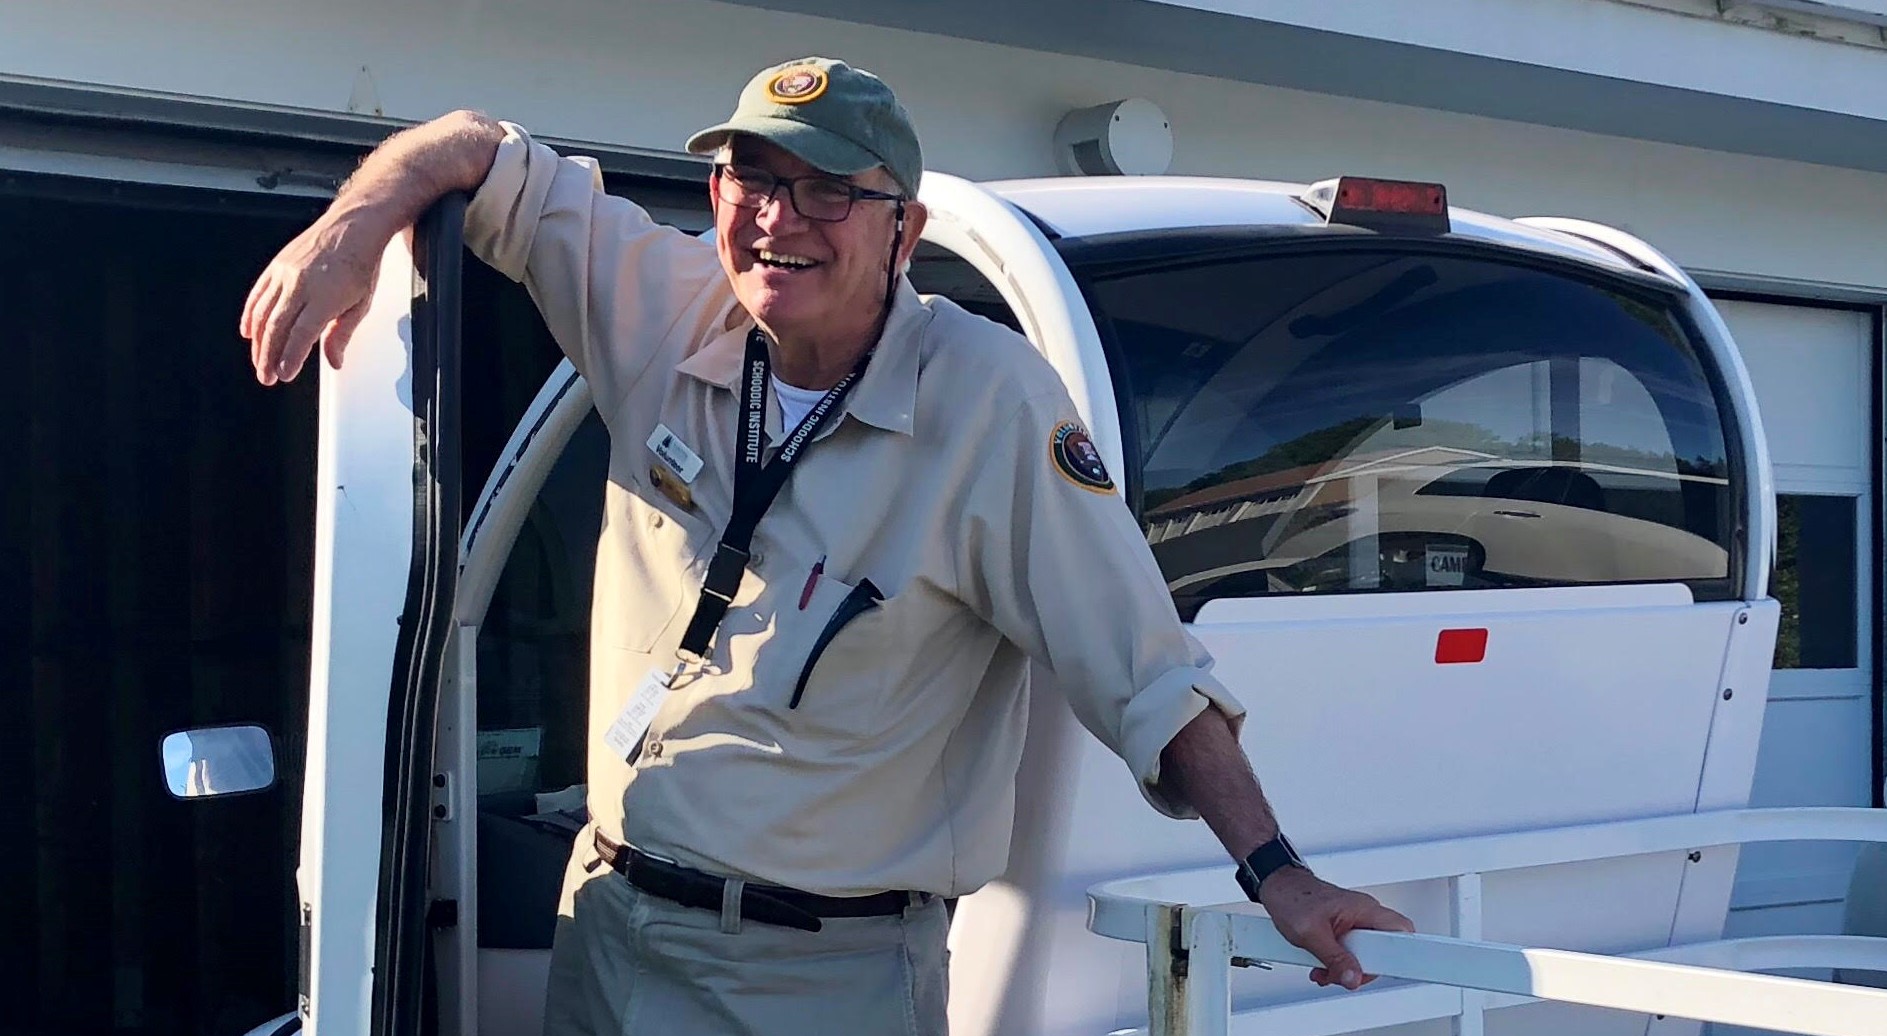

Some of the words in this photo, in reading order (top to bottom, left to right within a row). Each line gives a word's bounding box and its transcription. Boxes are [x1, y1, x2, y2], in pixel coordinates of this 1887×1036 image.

[749, 360, 765, 409] SCHOODIC
[746, 410, 761, 463] INSTITUTE
[780, 414, 820, 462] SCHOODIC
